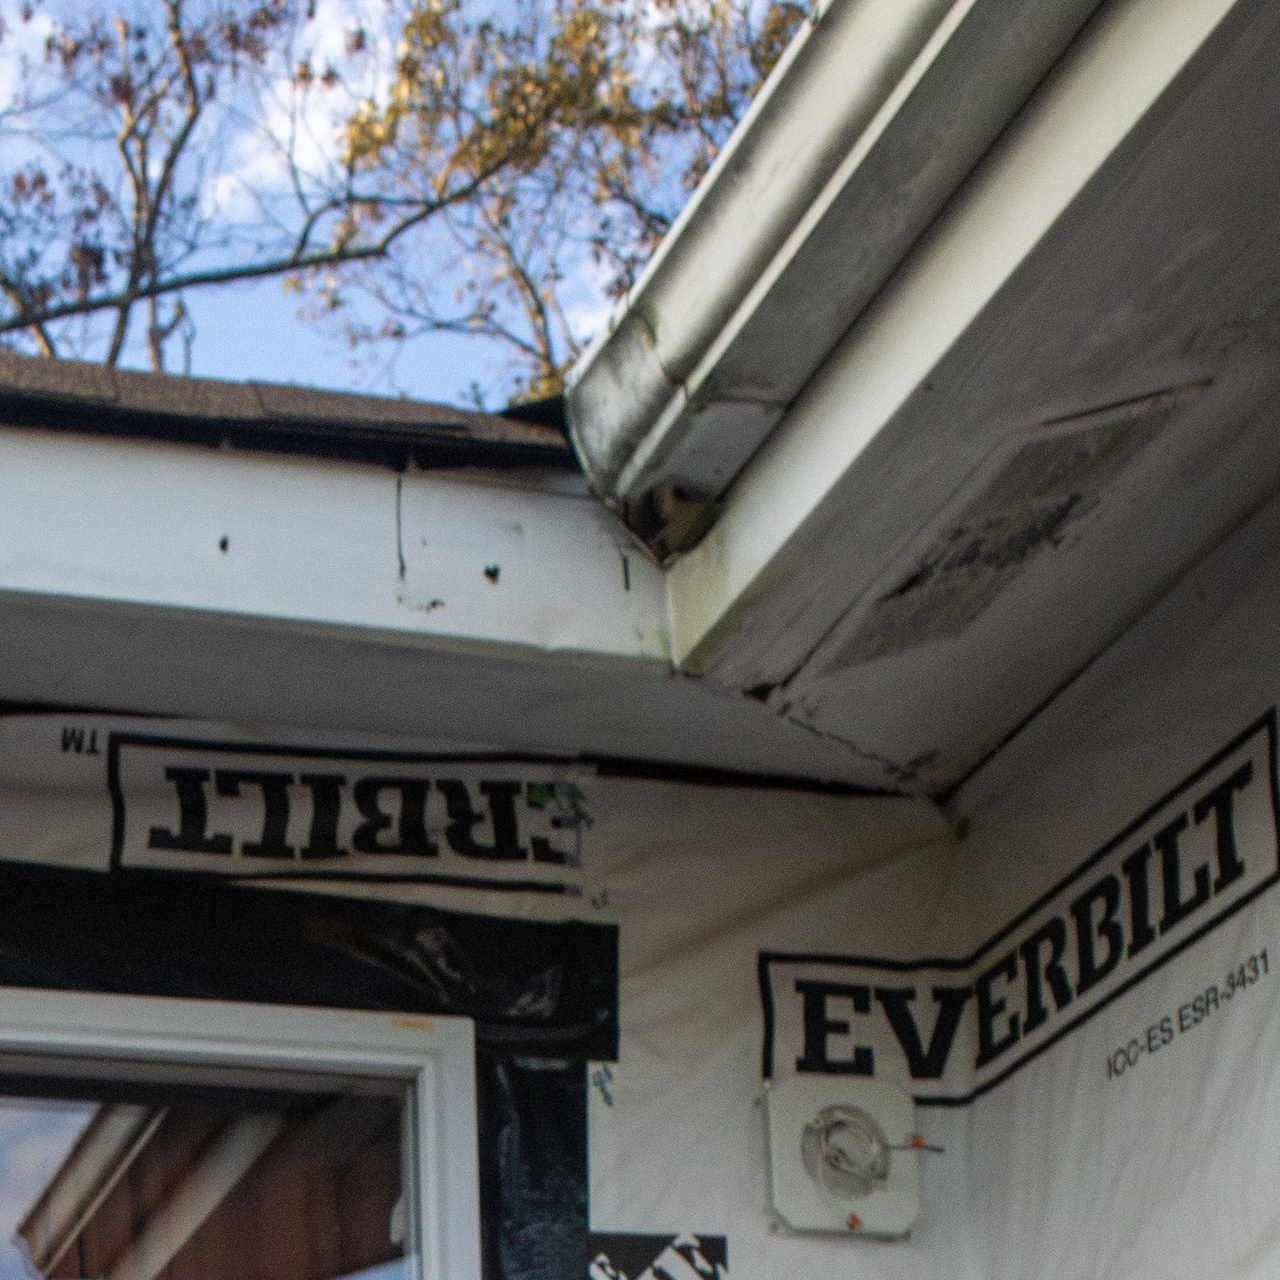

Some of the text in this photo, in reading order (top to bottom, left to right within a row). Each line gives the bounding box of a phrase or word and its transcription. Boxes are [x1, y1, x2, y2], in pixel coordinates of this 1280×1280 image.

[794, 759, 1254, 1080] EVERBILT
[1106, 948, 1270, 1080] ICC-ES ESR-3431
